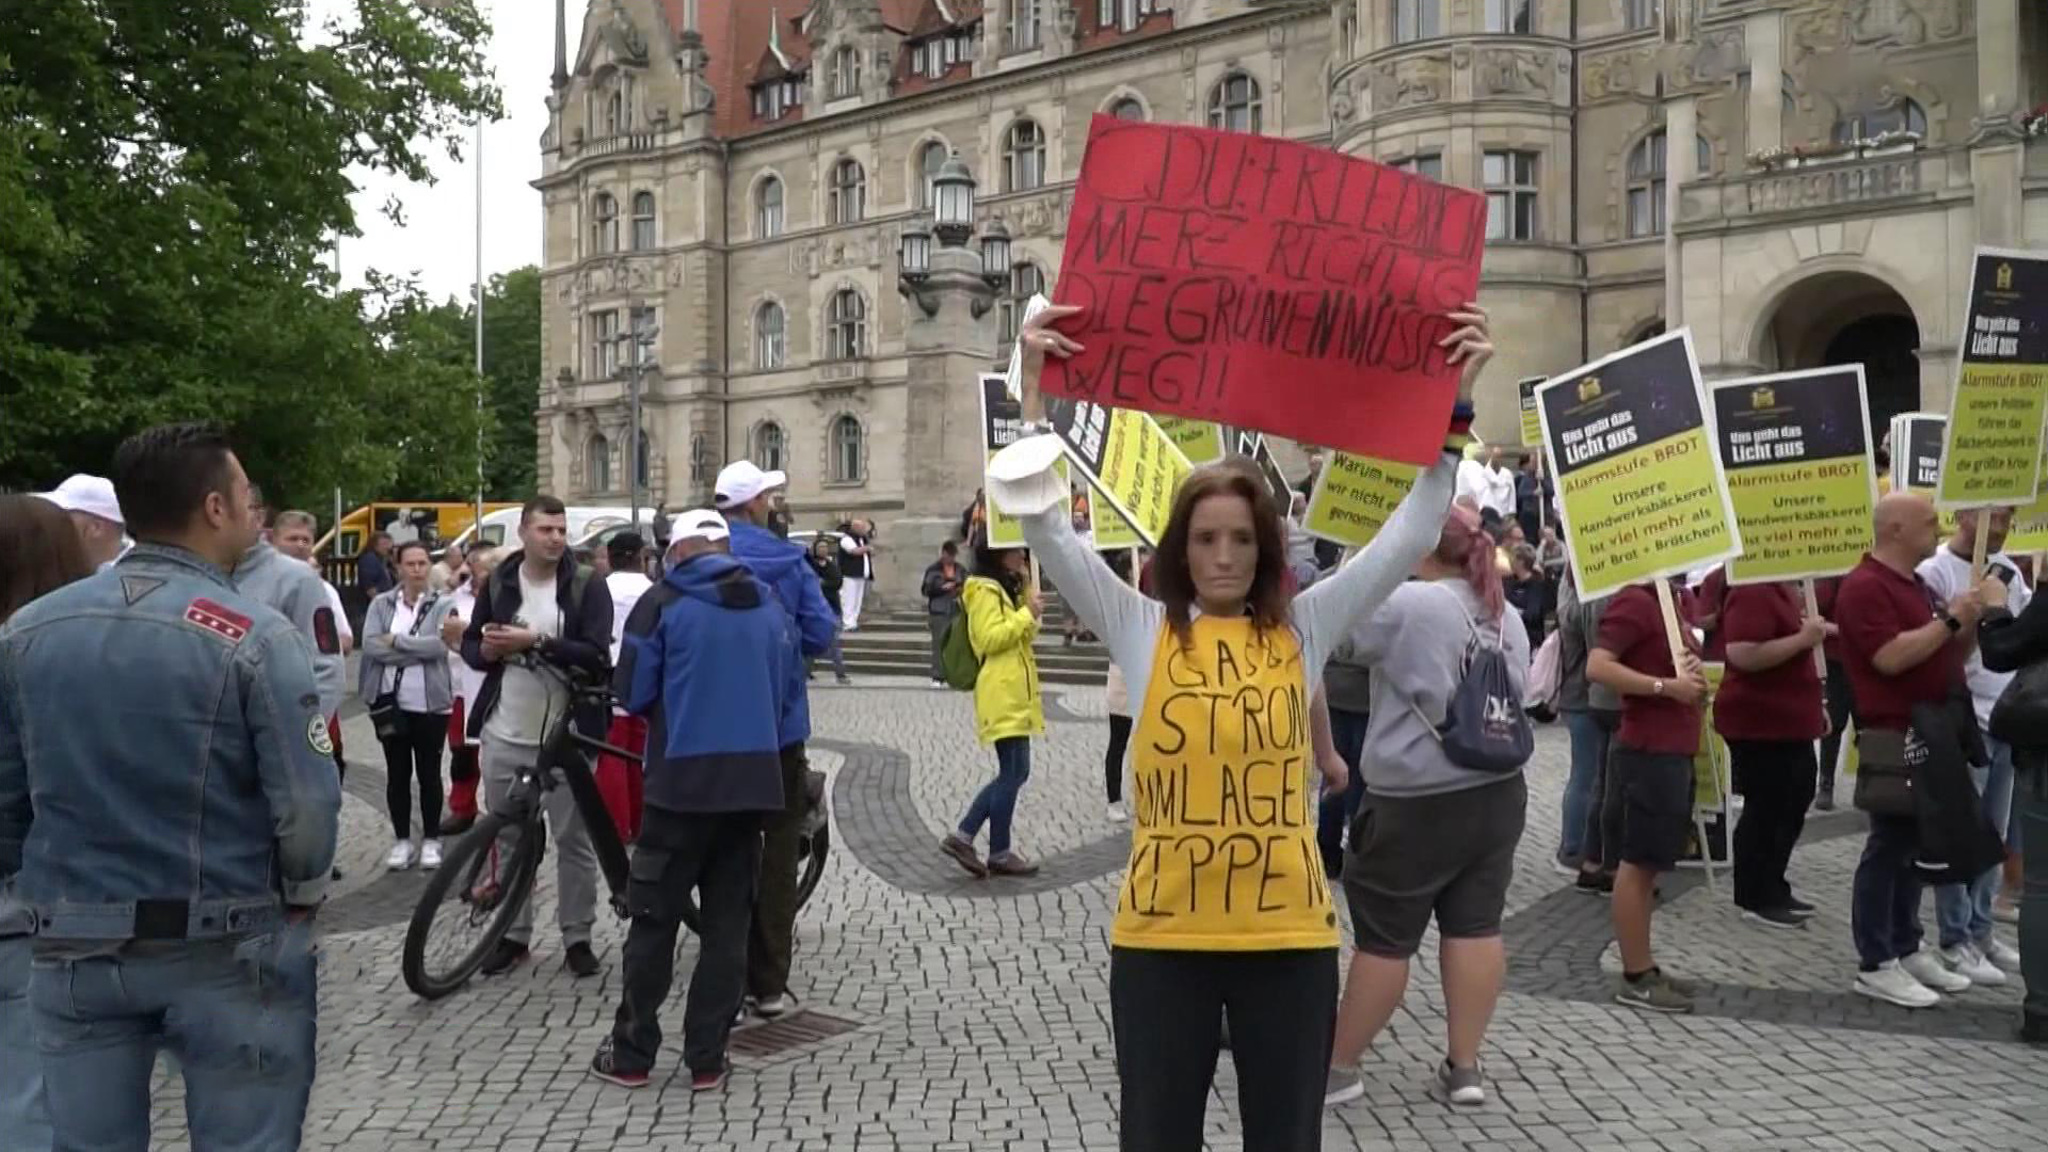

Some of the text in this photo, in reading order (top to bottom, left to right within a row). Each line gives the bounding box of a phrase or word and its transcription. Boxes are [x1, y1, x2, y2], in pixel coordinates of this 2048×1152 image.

[1565, 425, 1639, 466] Licht aus
[1732, 440, 1805, 463] Licht aus
[1334, 451, 1383, 480] Warum
[1565, 436, 1699, 495] Alarmstufe BROT
[1728, 462, 1860, 488] Alarmstufe BROT
[1917, 467, 1938, 483] Lic
[1349, 488, 1385, 508] nicht
[1613, 481, 1667, 506] Unsere
[1773, 493, 1826, 508] Unsere
[1328, 505, 1384, 529] genomm
[1643, 513, 1686, 537] mehr
[1691, 507, 1712, 522] als
[1799, 525, 1840, 541] mehr
[1844, 525, 1864, 536] als
[1584, 559, 1607, 576] nur
[1610, 549, 1639, 566] Brot
[1762, 548, 1791, 560] Brot
[1134, 756, 1308, 828] UMLAGE
